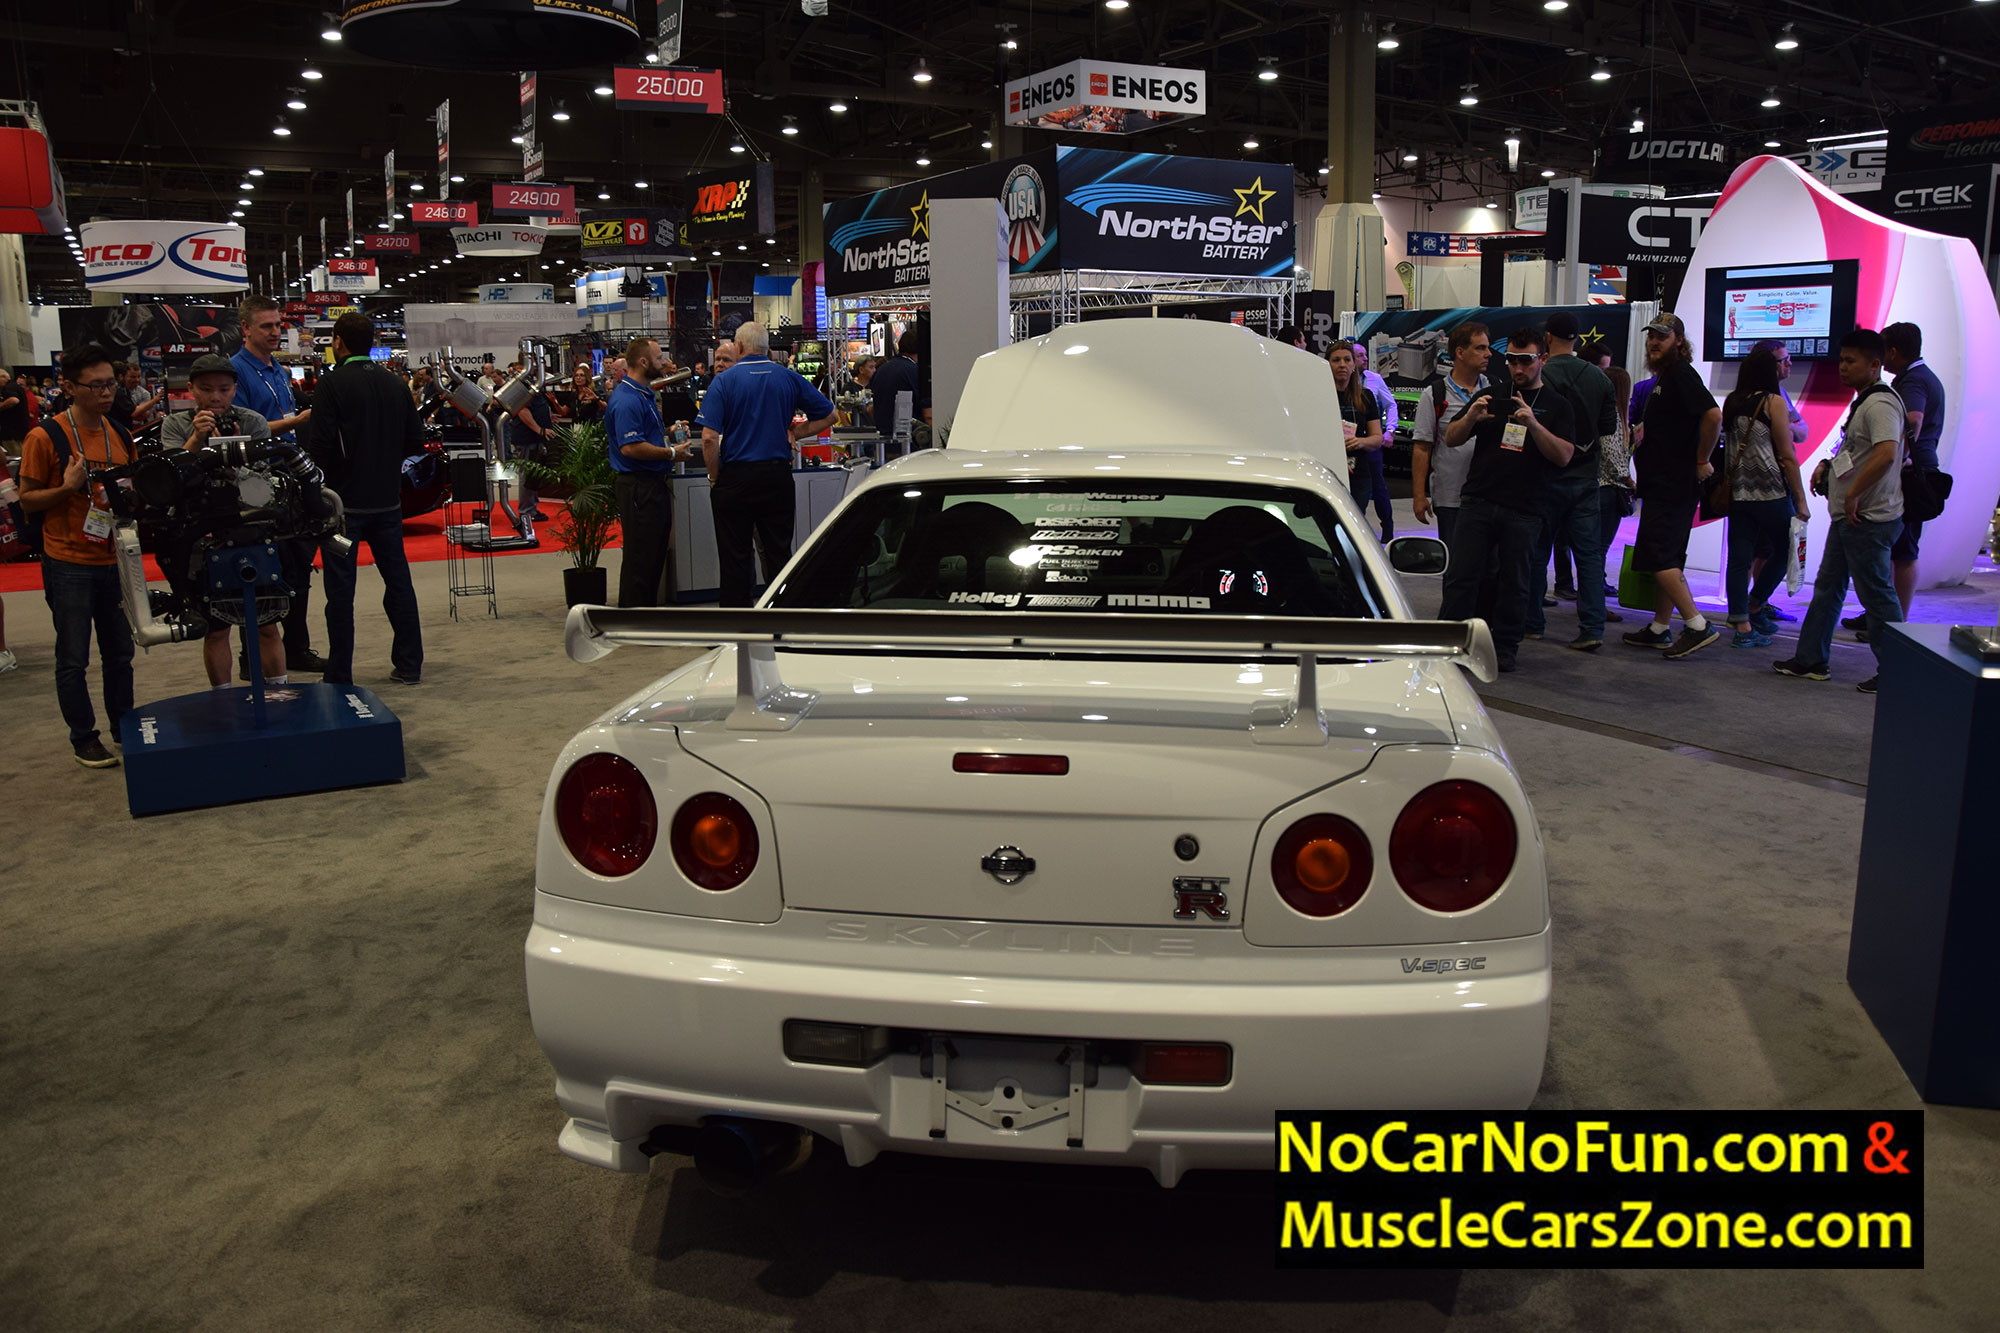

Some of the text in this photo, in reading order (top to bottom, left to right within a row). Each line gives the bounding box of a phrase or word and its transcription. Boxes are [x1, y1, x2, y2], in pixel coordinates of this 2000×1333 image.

[636, 76, 703, 97] 25000
[1022, 73, 1075, 110] ENEOS
[1113, 75, 1198, 104] ENEOS
[509, 191, 560, 206] 24900
[692, 182, 738, 215] XRP
[1894, 184, 1974, 208] CTEK
[425, 207, 466, 218] 24800
[1009, 188, 1036, 221] USA
[1099, 210, 1283, 244] NorthStar
[376, 238, 410, 247] 24700
[456, 231, 502, 246] HITACHI
[1203, 243, 1268, 260] BATTERY
[1627, 253, 1687, 263] MAXIMIZING
[338, 262, 368, 270] 24600
[1075, 549, 1123, 557] GIKEN
[948, 592, 1021, 607] Holley
[1025, 594, 1103, 607] TURBOSMART
[826, 920, 1196, 957] SKYLINE
